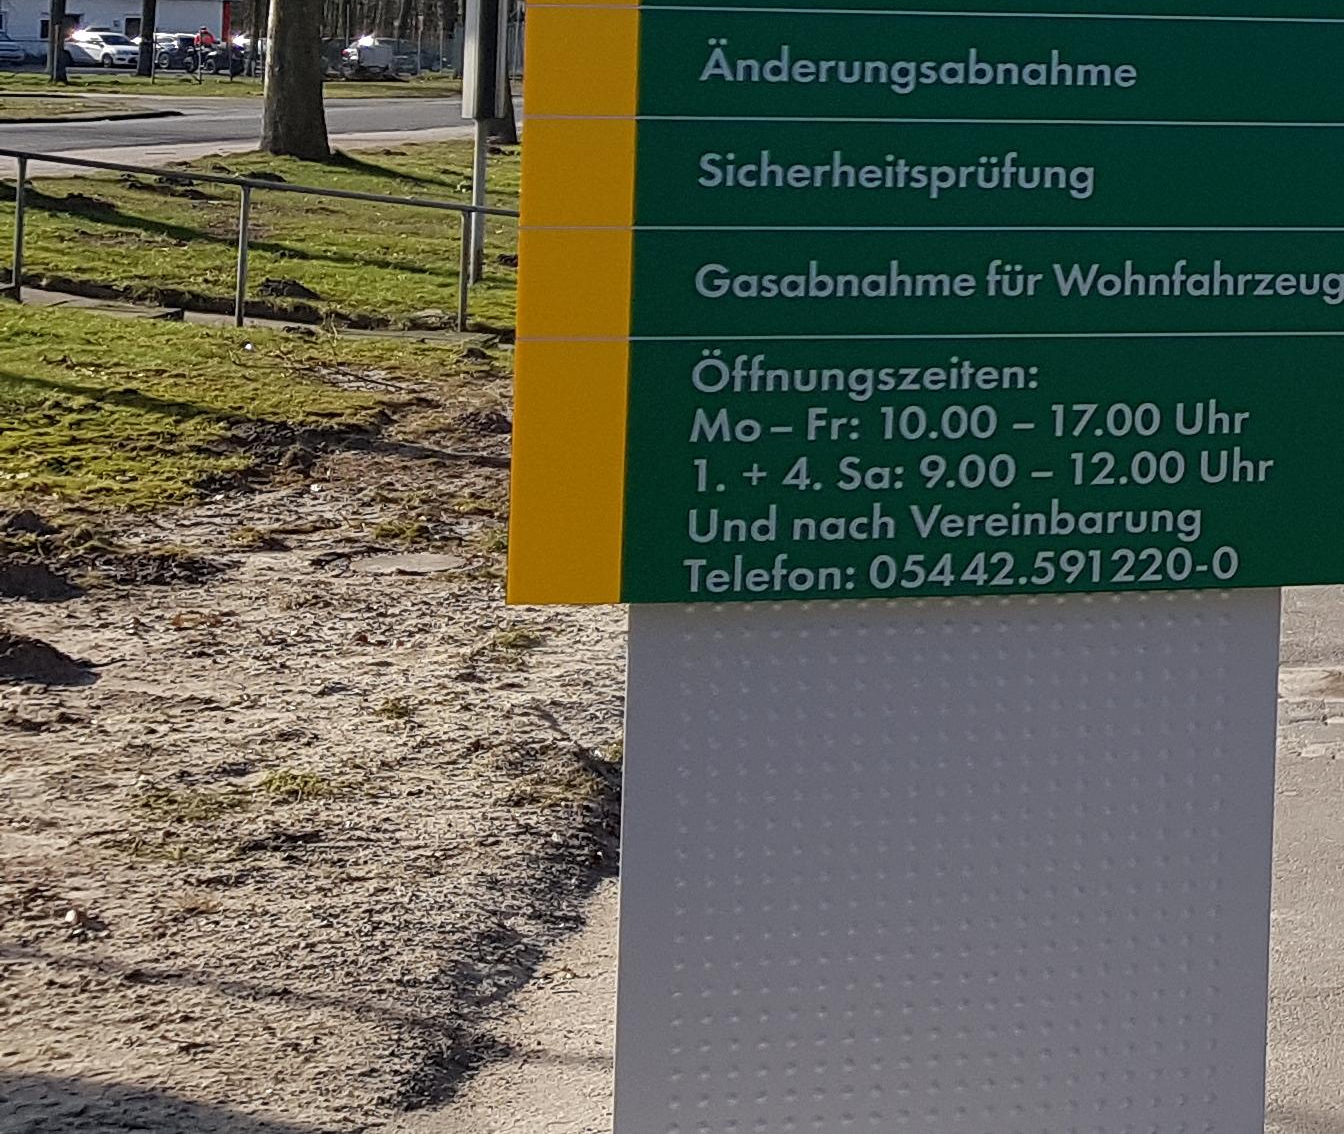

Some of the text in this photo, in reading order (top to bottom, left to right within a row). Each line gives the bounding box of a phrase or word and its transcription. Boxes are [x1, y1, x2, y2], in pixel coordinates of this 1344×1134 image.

[699, 38, 1137, 94] Änderungsabnahme
[698, 150, 1094, 199] Sicherheitsprüfung
[695, 260, 976, 298] Gasabnahme
[986, 259, 1043, 297] für
[692, 348, 1038, 402] Öffnungszeiten:
[689, 408, 761, 443] Mo
[807, 407, 859, 441] Fr:
[880, 404, 998, 440] 10.00
[1051, 402, 1161, 437] 17.00
[1175, 398, 1250, 436] Uhr
[693, 458, 725, 492] 1.
[742, 463, 767, 486] +
[782, 456, 822, 491] 4.
[837, 456, 904, 491] Sa:
[919, 453, 1016, 489] 9.00
[1070, 450, 1185, 485] 12.00
[1200, 446, 1274, 484] Uhr
[688, 499, 1202, 543] Und nach Vereinbarung
[683, 545, 1240, 593] Telefon: 05442.591220-0
